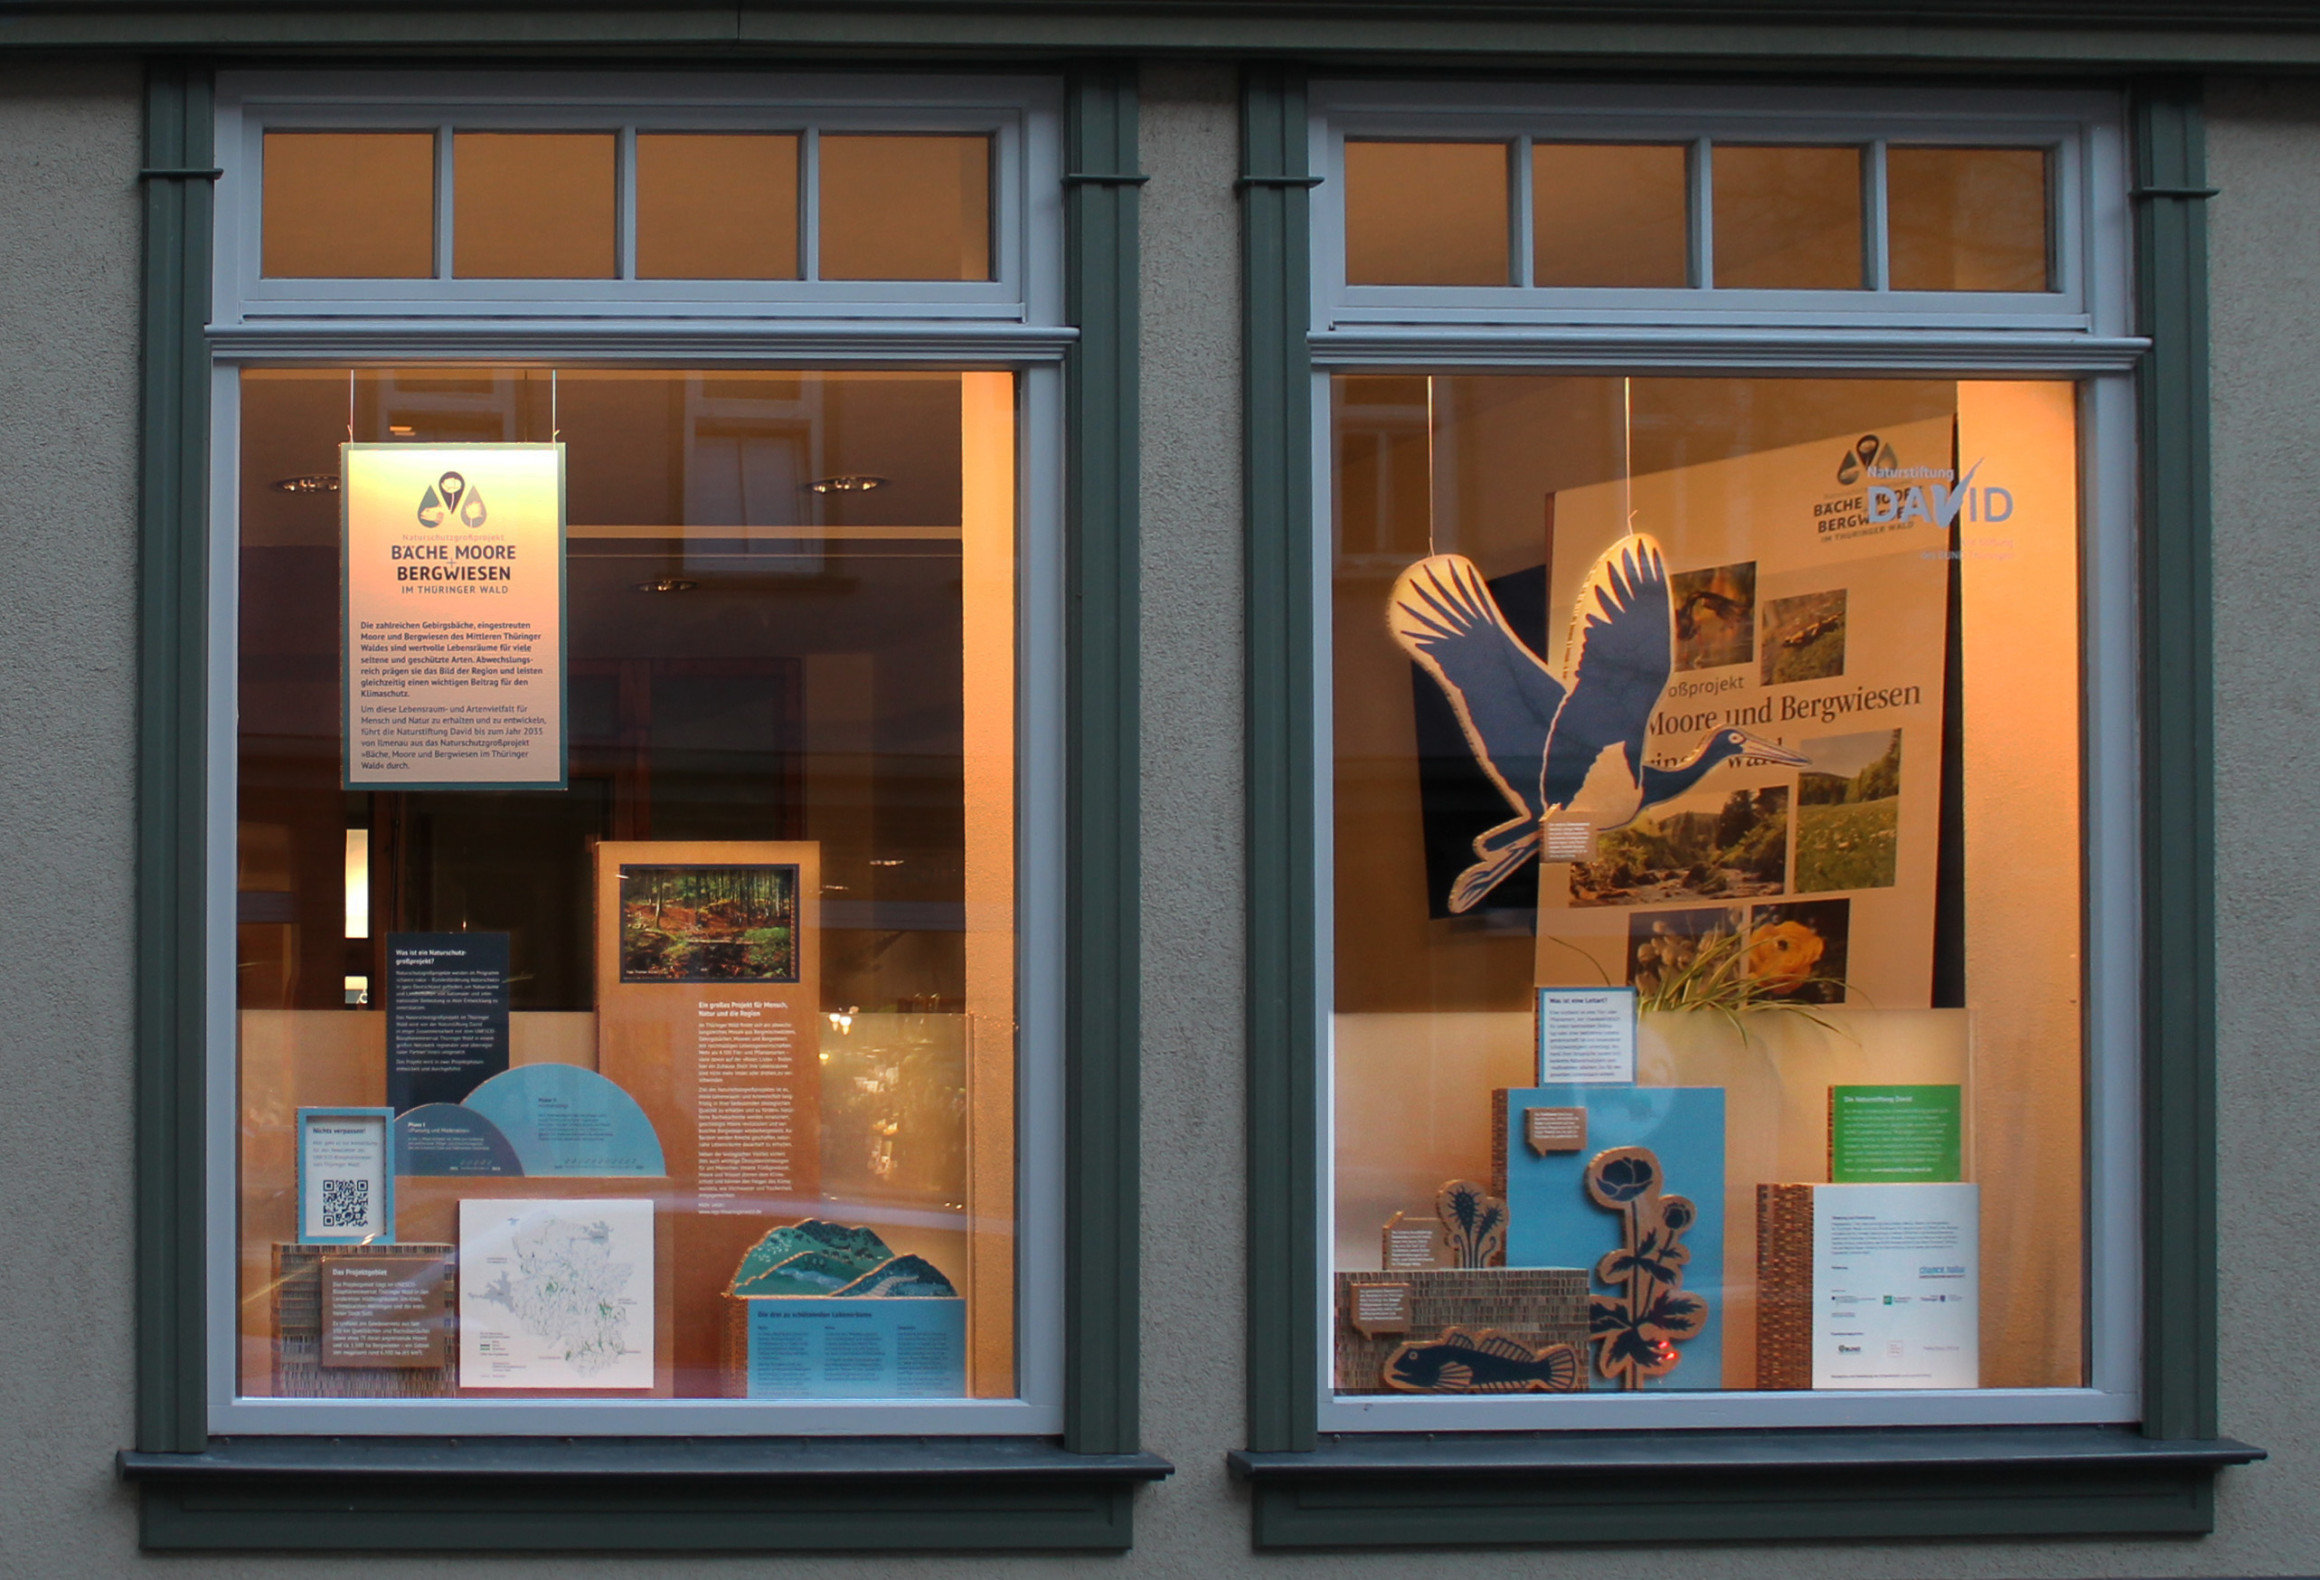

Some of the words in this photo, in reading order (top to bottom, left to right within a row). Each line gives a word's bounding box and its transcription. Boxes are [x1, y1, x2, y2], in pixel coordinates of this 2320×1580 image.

[1867, 466, 1955, 482] Naturstiftung
[1868, 460, 2013, 528] DAVID
[392, 545, 448, 560] BÄCHE
[456, 545, 516, 560] MOORE
[398, 566, 510, 581] BERGWIESEN
[402, 586, 413, 594] IM
[417, 585, 475, 594] THÜRINGER
[479, 585, 508, 594] WALD
[360, 621, 374, 630] Die
[375, 621, 420, 630] zahlreichen
[477, 621, 531, 631] eingestreuten
[360, 633, 385, 641] Moore
[404, 632, 449, 642] Bergwiesen
[503, 632, 541, 642] Thüringer
[360, 644, 389, 652] Waldes
[390, 644, 407, 652] sind
[408, 644, 445, 652] wertvolle
[500, 644, 511, 652] für
[513, 644, 531, 652] viele
[360, 655, 389, 664] seltene
[391, 656, 406, 664] und
[407, 656, 449, 665] geschützte
[476, 656, 533, 665] Abwechslungs-
[360, 667, 380, 675] reich
[382, 667, 409, 677] prägen
[411, 667, 422, 675] sie
[439, 667, 455, 675] Bild
[456, 667, 470, 675] der
[471, 667, 498, 676] Region
[517, 667, 543, 675] leisten
[360, 678, 406, 688] gleichzeitig
[407, 678, 429, 686] einen
[431, 678, 469, 688] wichtigen
[470, 678, 499, 688] Beitrag
[500, 678, 512, 686] für
[1668, 676, 1744, 698] oßprojekt
[361, 705, 374, 714] Um
[376, 705, 397, 713] diese
[449, 705, 465, 713] und
[466, 705, 515, 713] Artenvielfalt
[516, 705, 527, 713] für
[1725, 697, 1772, 726] und
[1781, 685, 1921, 724] Bergwiesen
[361, 716, 390, 725] Mensch
[392, 716, 407, 725] und
[408, 716, 430, 724] Natur
[442, 716, 474, 725] erhalten
[476, 716, 491, 724] und
[361, 728, 381, 736] führt
[382, 728, 395, 736] die
[396, 727, 448, 737] Naturstiftung
[450, 727, 472, 736] David
[474, 727, 485, 736] bis
[505, 727, 521, 735] Jahr
[377, 739, 408, 747] Ilmenau
[425, 739, 439, 747] das
[440, 739, 529, 748] Naturschutzgroßprojekt
[392, 750, 416, 758] Moore
[418, 750, 433, 758] und
[434, 750, 478, 760] Bergwiesen
[492, 750, 528, 759] Thüringer
